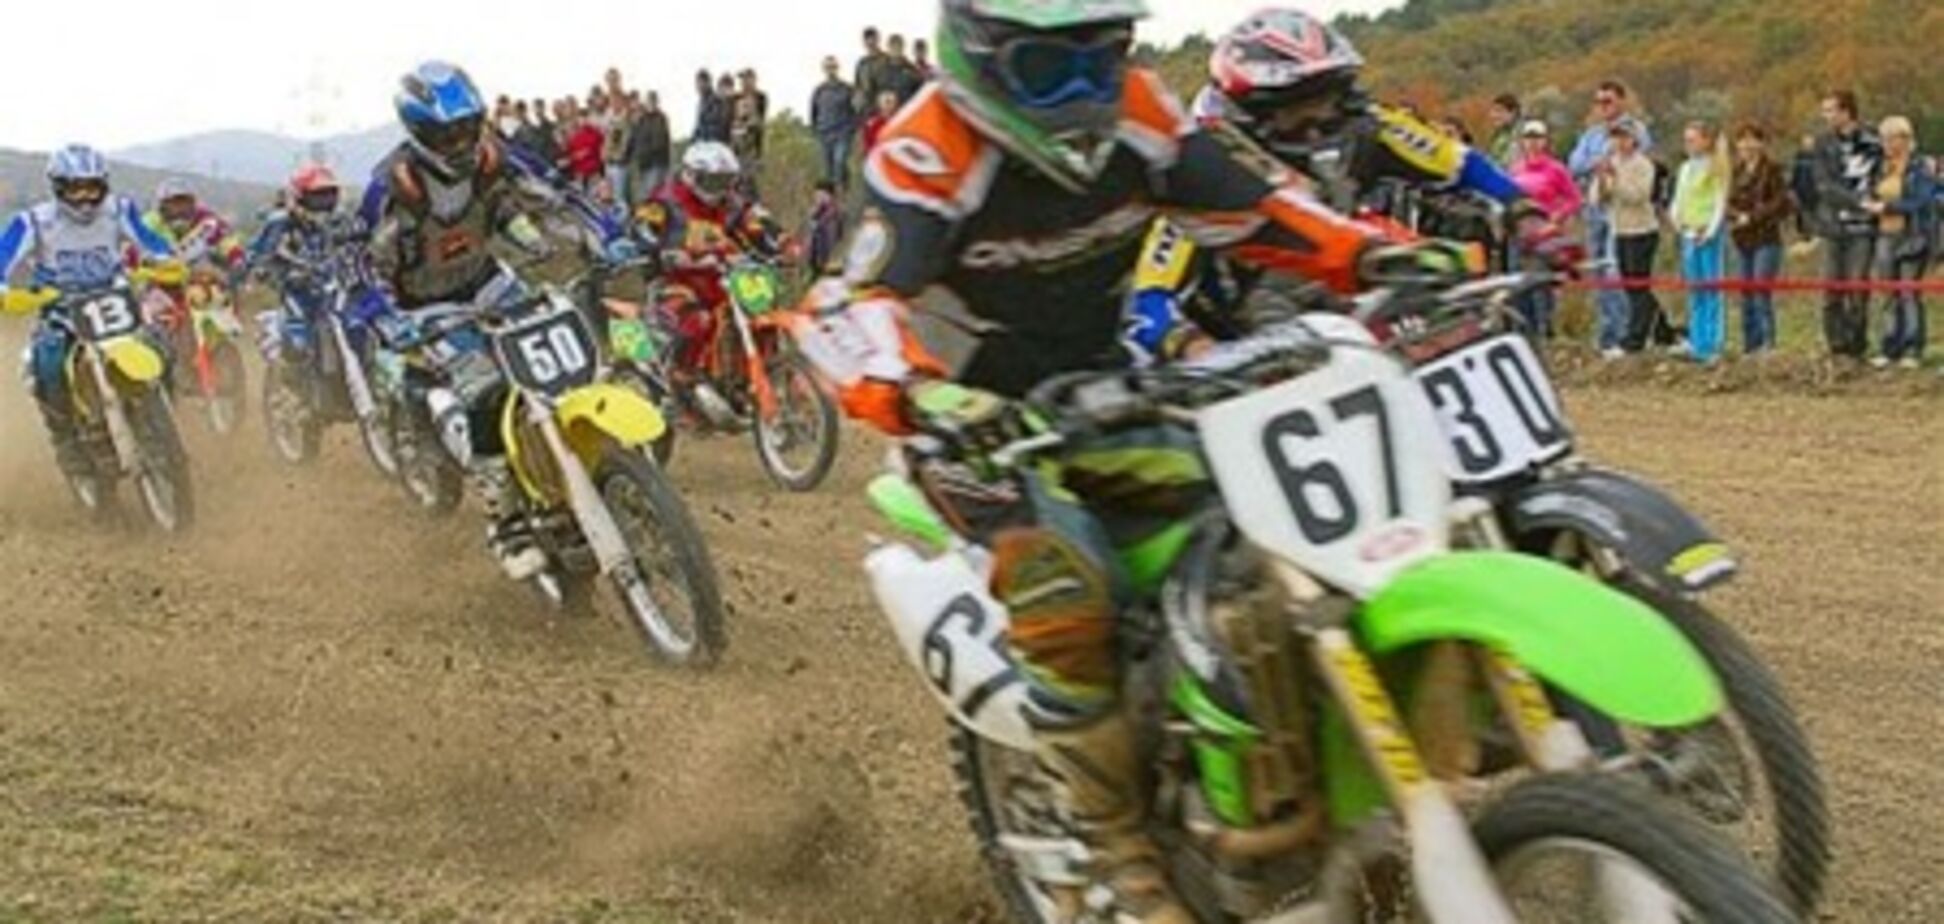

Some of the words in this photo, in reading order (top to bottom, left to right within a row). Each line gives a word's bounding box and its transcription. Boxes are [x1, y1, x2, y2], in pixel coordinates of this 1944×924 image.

[82, 295, 134, 334] 13
[518, 325, 586, 382] 50
[1261, 384, 1402, 545] 67
